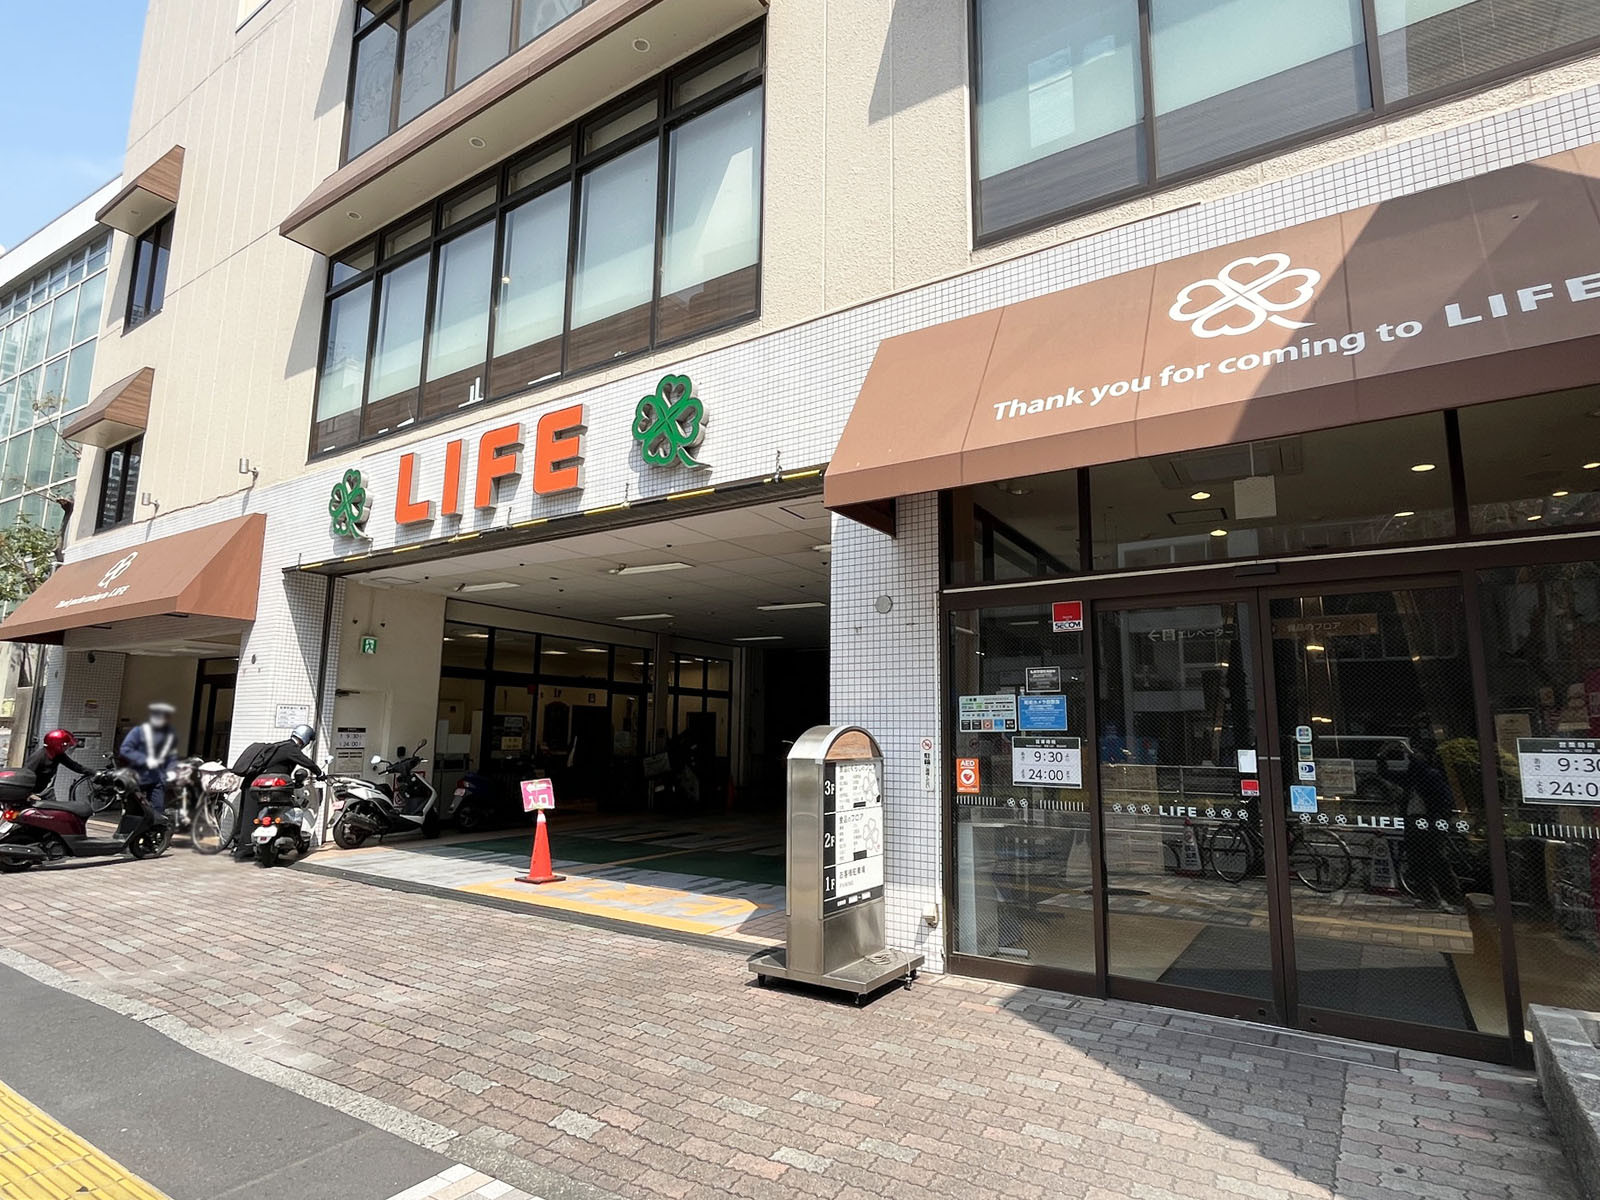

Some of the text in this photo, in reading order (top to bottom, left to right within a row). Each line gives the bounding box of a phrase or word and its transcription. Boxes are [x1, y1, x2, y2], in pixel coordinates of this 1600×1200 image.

[993, 272, 1600, 421] Thank you for coming to LIFE
[395, 404, 586, 525] LIFE
[1055, 621, 1081, 630] SECOM
[1178, 628, 1234, 639] エレベーター
[1033, 751, 1063, 763] 9:30
[1557, 757, 1600, 773] 9:3
[1028, 768, 1064, 781] 24:00
[824, 780, 835, 796] 3F
[1159, 805, 1197, 817] LIFE
[1357, 815, 1404, 829] LIFE
[824, 832, 835, 849] 2F
[825, 876, 836, 892] 1F
